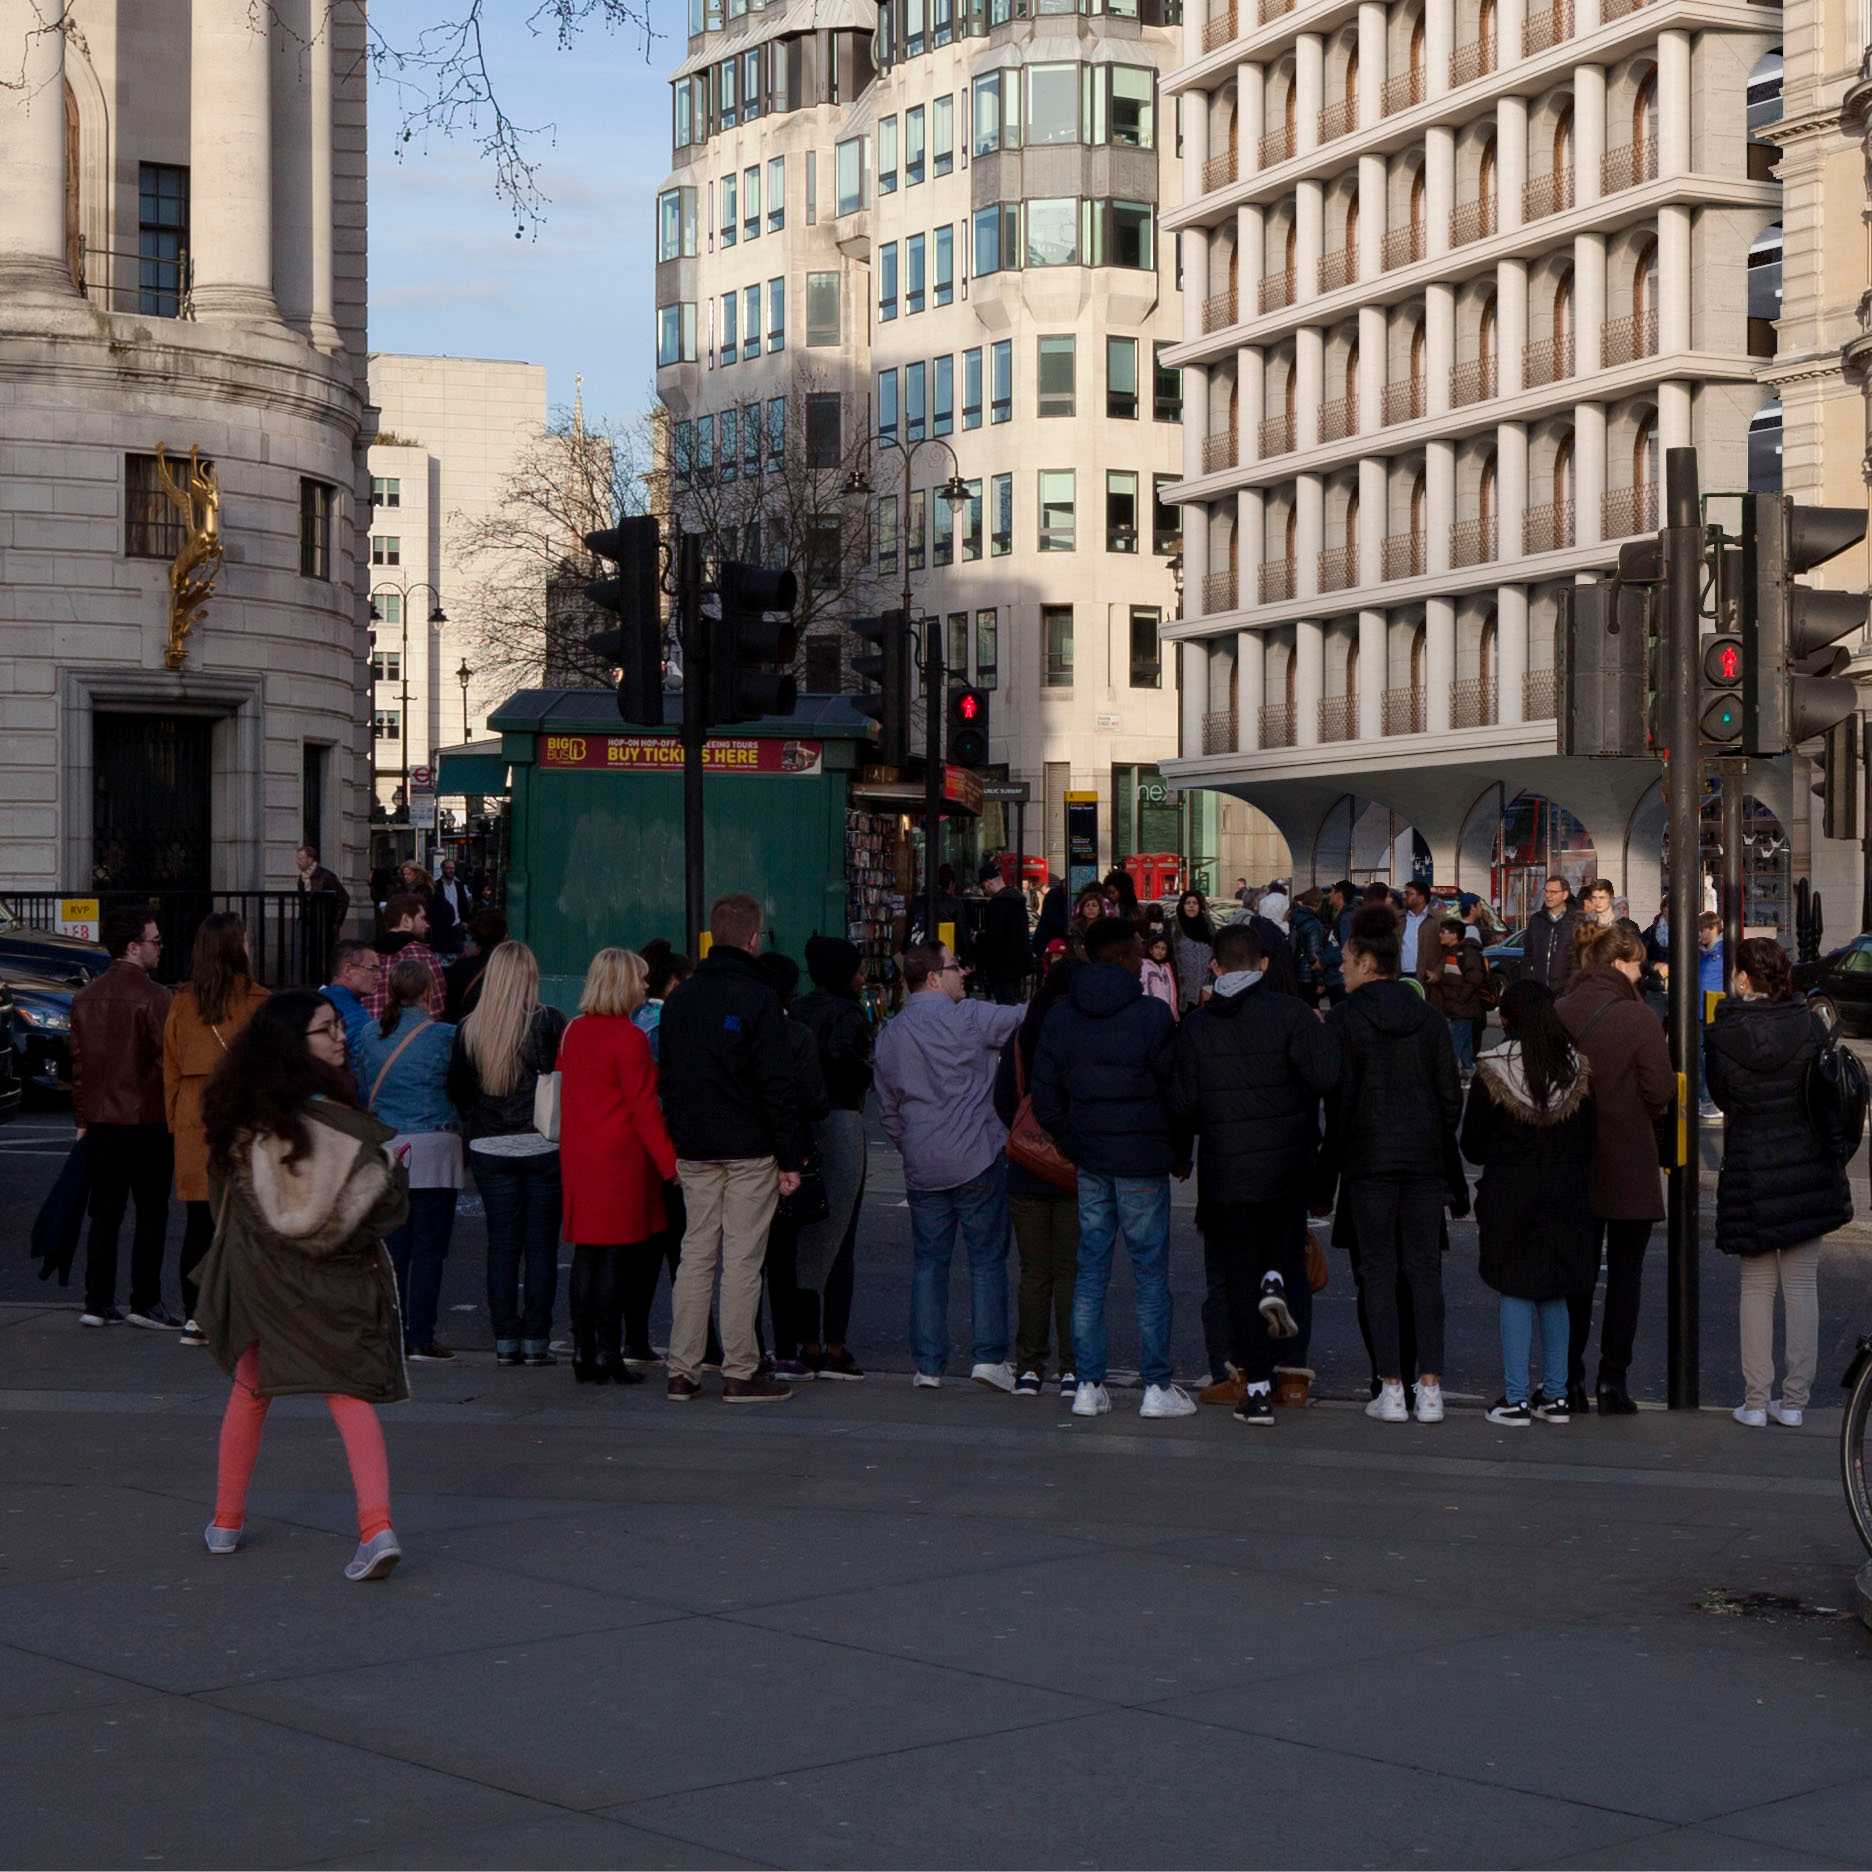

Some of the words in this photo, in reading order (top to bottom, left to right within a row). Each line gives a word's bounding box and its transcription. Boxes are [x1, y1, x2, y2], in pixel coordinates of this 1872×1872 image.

[547, 737, 569, 749] BIG
[608, 747, 639, 762] BUY
[643, 747, 709, 763] TICKS
[715, 749, 759, 764] HERE
[71, 905, 90, 915] RVP
